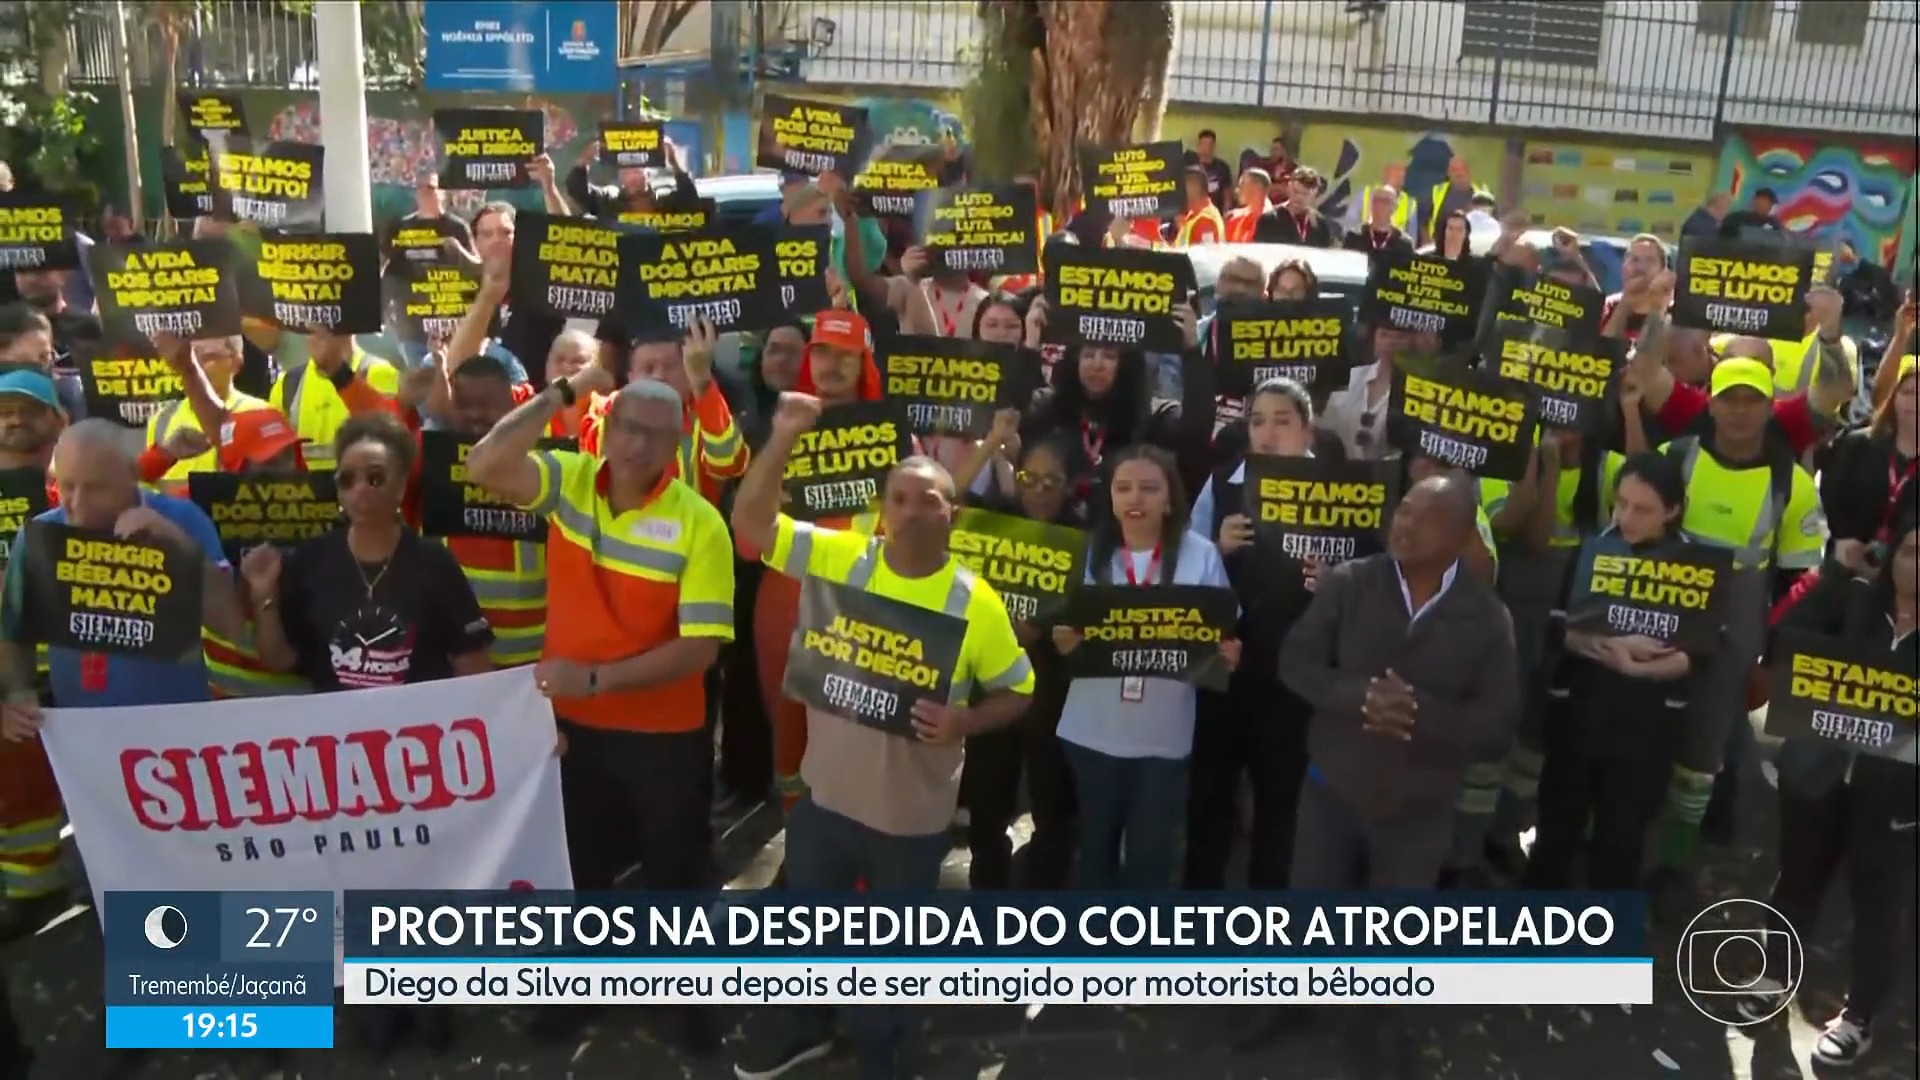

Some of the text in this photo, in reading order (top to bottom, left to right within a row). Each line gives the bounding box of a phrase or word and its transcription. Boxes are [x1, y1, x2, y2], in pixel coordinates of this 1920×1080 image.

[790, 106, 842, 125] A VIDA
[773, 118, 854, 140] DOS GARIS
[445, 143, 535, 156] POR DIEGO!
[776, 132, 849, 153] IMPORTA!
[218, 153, 312, 179] ESTAMOS
[1114, 150, 1146, 162] LUTO
[1099, 163, 1124, 175] POR
[1116, 173, 1148, 184] LUTA
[219, 171, 242, 190] DE
[245, 175, 308, 199] LUTO!
[853, 174, 939, 190] POR DIEGO!
[1094, 185, 1119, 197] POR
[955, 193, 993, 206] LUTO
[0, 207, 62, 225] AMOS
[935, 206, 1013, 220] POR DIEGO
[956, 220, 993, 232] LUTA
[661, 238, 736, 260] A VIDA
[926, 233, 956, 246] POR
[126, 251, 195, 269] A VIDA
[262, 242, 346, 260] DIRIGIR
[539, 240, 619, 268] BÊBAD
[258, 260, 353, 281] BÊBADO
[550, 264, 618, 288] MATA!
[640, 254, 760, 281] DOS GARIS
[779, 259, 816, 277] TO!
[1389, 268, 1419, 285] POR
[1411, 260, 1448, 275] LUTO
[1690, 257, 1799, 284] ESTAMOS
[108, 268, 219, 290] DOS GARIS
[648, 273, 757, 299] IMPORTA!
[1060, 266, 1174, 292] ESTAMOS
[116, 287, 216, 307] IMPORTA!
[272, 283, 341, 301] MATA!
[1060, 286, 1171, 314] DE LUTO!
[1376, 289, 1406, 304] POR
[1407, 284, 1441, 300] LUTA
[1512, 289, 1543, 306] POR
[1535, 282, 1571, 300] LUTO
[1689, 278, 1794, 305] DE LUTO!
[1231, 318, 1342, 340] ESTAMOS
[1233, 338, 1339, 360] DE LUTO!
[1502, 340, 1612, 377] ESTAMOS
[91, 358, 174, 378] ESTAM
[887, 355, 1001, 382] ESTAMOS
[96, 376, 184, 396] DE LUTO
[888, 377, 997, 403] DE LUTO!
[1500, 361, 1607, 398] DE LUTO!
[1405, 374, 1525, 422] ESTAMOS
[1404, 399, 1437, 425] DE
[1440, 407, 1519, 443] LUTO!
[791, 422, 897, 456] STAMOS
[818, 445, 897, 475] LUTO!
[235, 483, 315, 501] A VIDA
[1260, 478, 1386, 503] ESTAMOS
[212, 501, 339, 520] DOS GARIS
[1261, 501, 1381, 529] DE LUTO!
[66, 538, 165, 571] DIRIGIR
[949, 529, 1073, 571] ESTAMOS
[1283, 533, 1355, 558] SIEMACO
[56, 558, 172, 595] BÊBADO
[989, 559, 1067, 593] LUTO!
[1593, 554, 1715, 589] ESTAMOS
[70, 587, 156, 614] MATA!
[1590, 574, 1710, 610] DE LUTO!
[69, 612, 154, 642] SIEMACO
[1103, 608, 1203, 629] JUSTIÇA
[1084, 626, 1221, 643] POR DIEGO!
[804, 629, 939, 690] POR DIEGO!
[1792, 653, 1920, 696] ESTAMO
[1791, 676, 1920, 717] DE LUTO
[1811, 709, 1894, 743] SIEMACO
[120, 718, 495, 831] SIEMACO
[215, 823, 431, 863] SÃO PAULO
